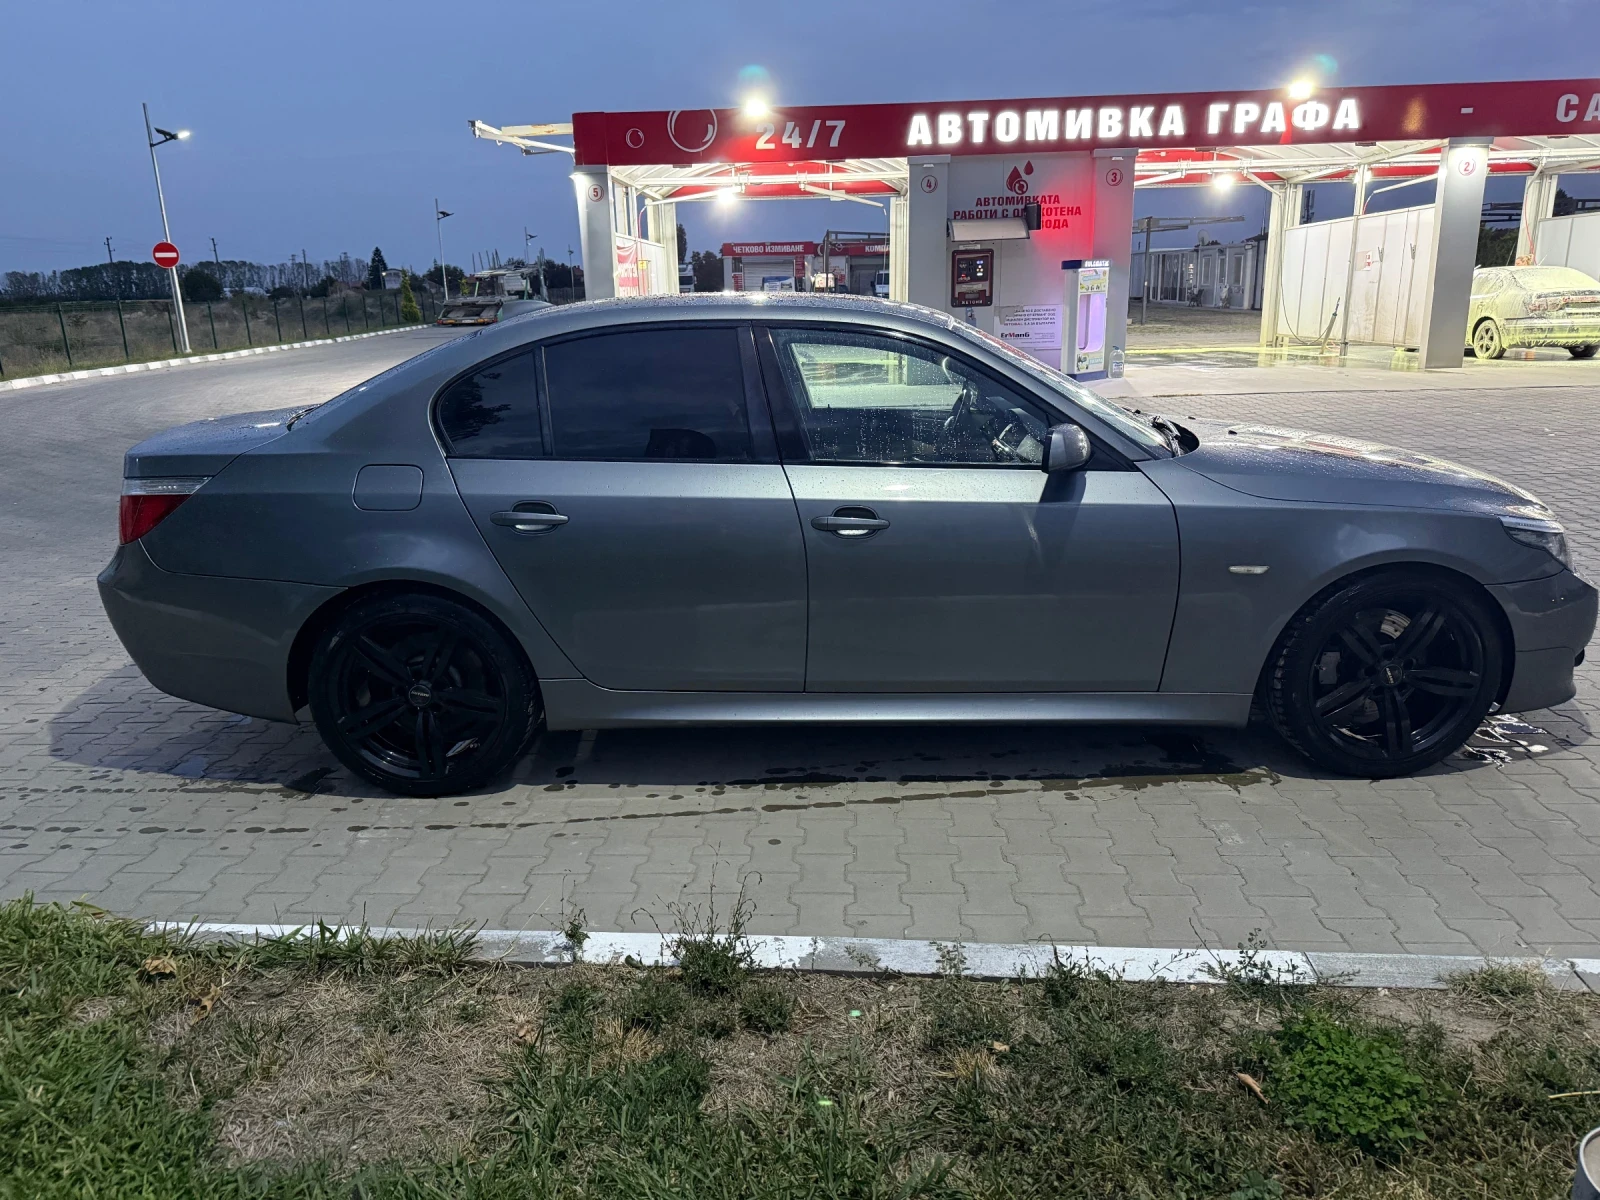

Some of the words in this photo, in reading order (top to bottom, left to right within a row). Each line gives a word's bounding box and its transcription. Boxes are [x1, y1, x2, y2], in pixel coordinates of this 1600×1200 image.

[907, 105, 1186, 146] АВТОМИВКА
[1207, 99, 1360, 134] ГРАФА
[755, 120, 846, 150] 24/7
[975, 194, 1060, 207] АВТОМИВКАТА
[953, 209, 998, 220] РАБОТИ
[1001, 208, 1009, 218] С
[732, 245, 764, 253] ЧЕТКОВО
[765, 244, 805, 253] ИЗМИВАНЕ
